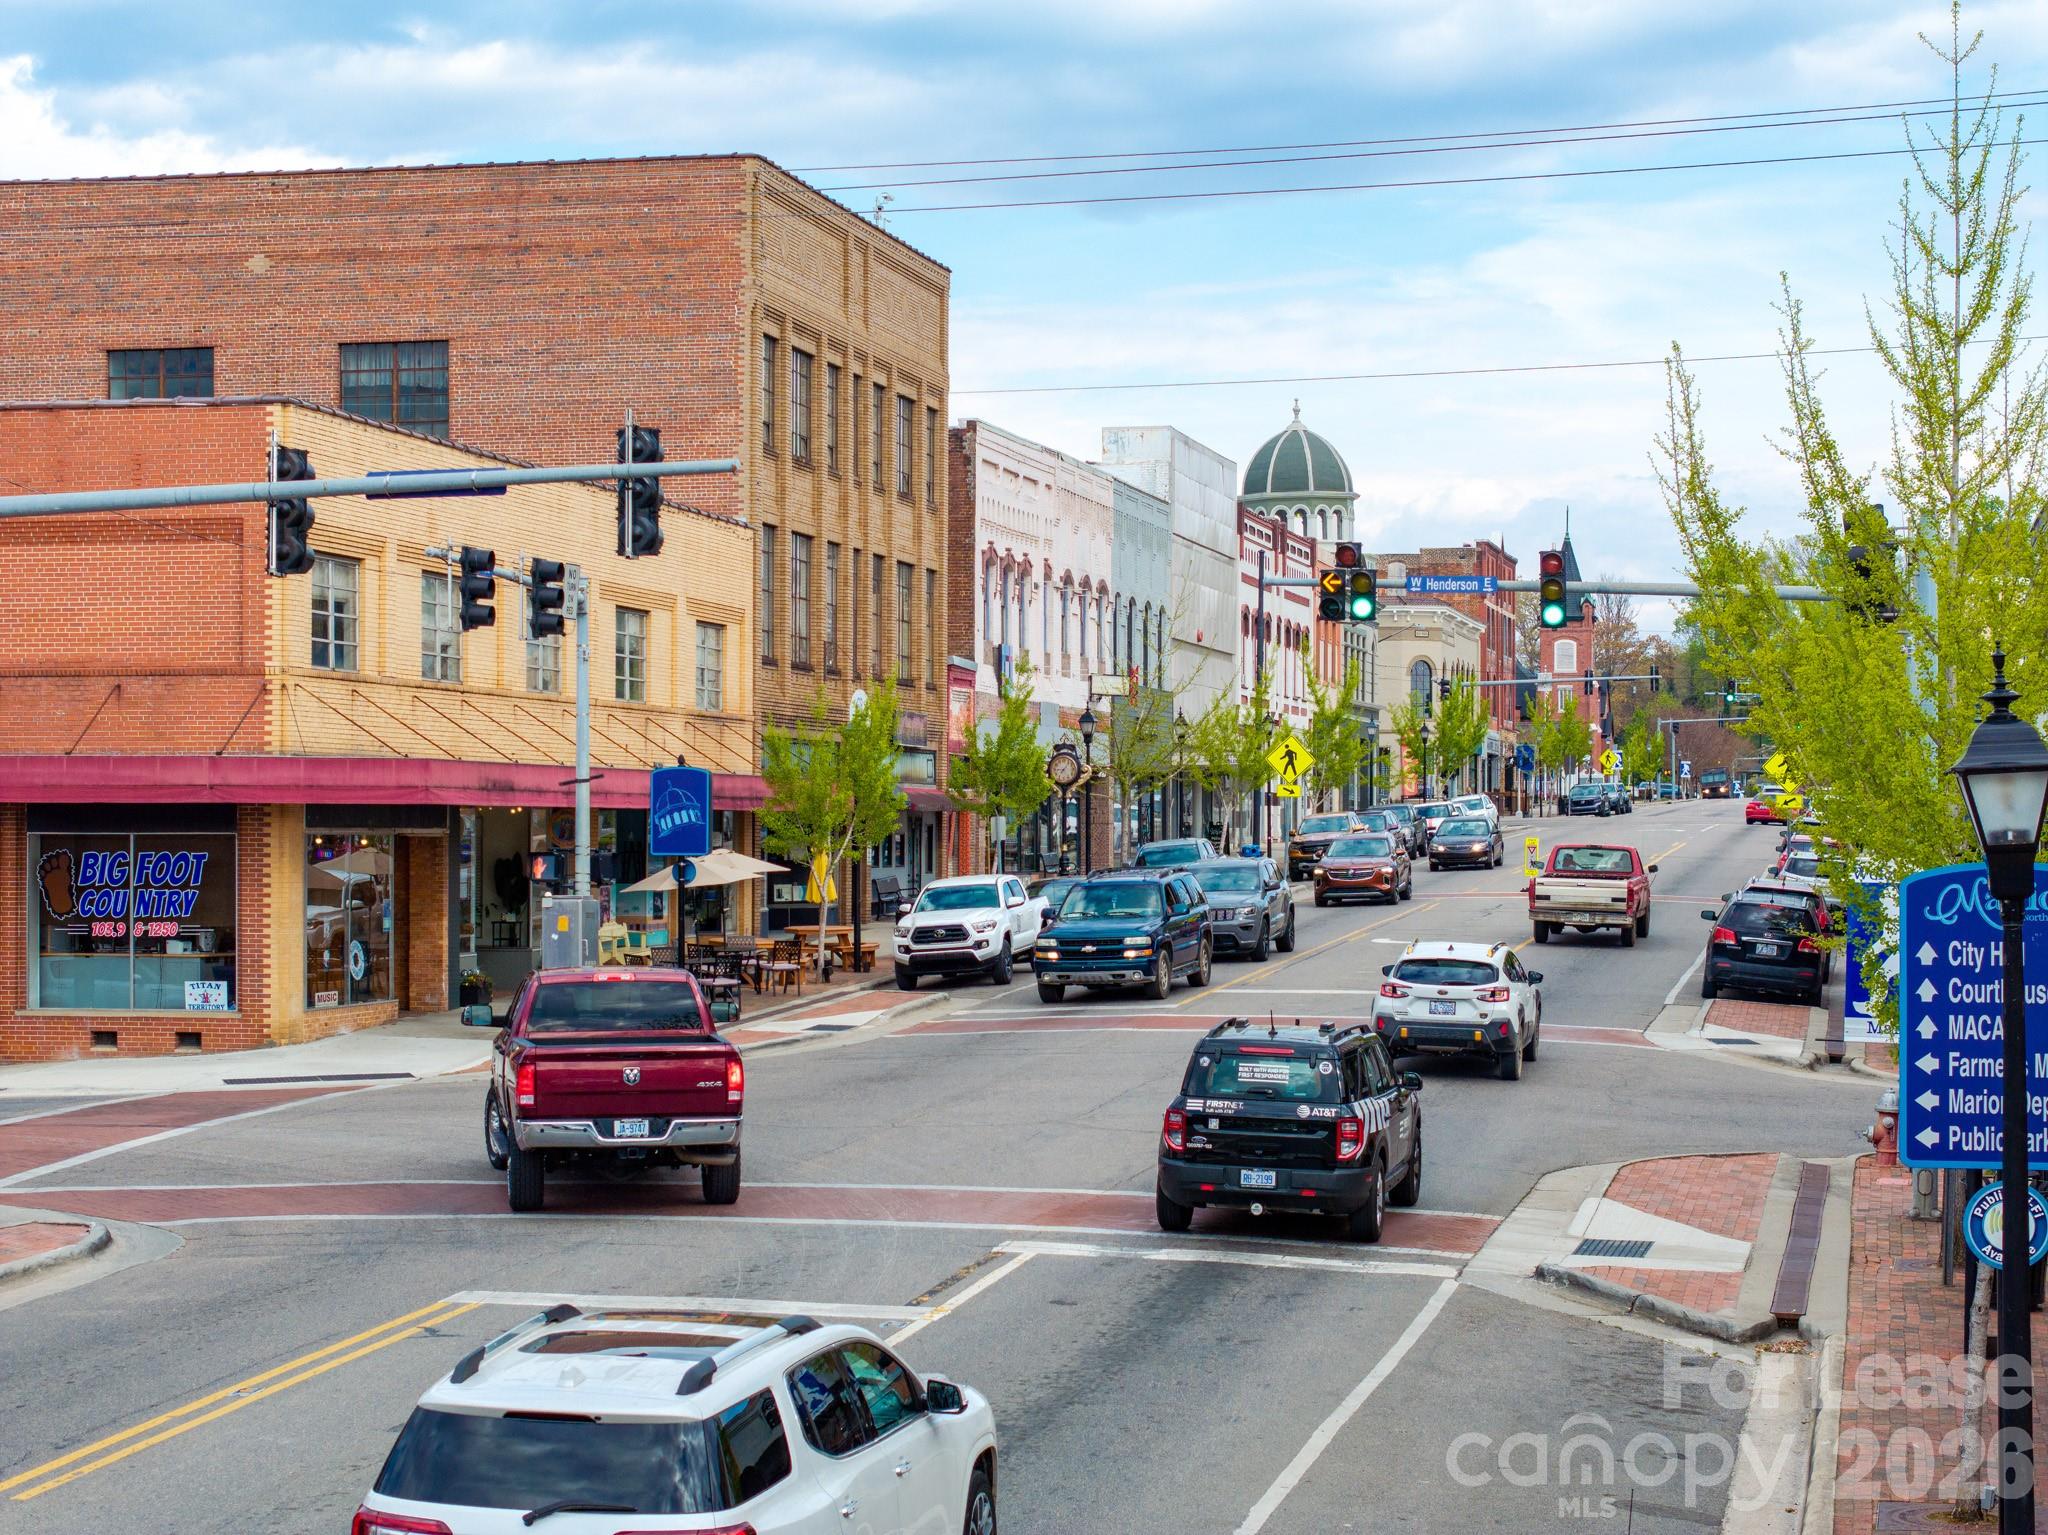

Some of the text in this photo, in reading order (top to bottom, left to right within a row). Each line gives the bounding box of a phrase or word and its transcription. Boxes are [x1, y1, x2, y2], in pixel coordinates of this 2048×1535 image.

[1411, 577, 1491, 590] W Henderson E
[77, 850, 208, 887] BIG FOOT
[91, 921, 179, 938] 103.9 & 1250
[1948, 940, 1985, 973] City
[190, 982, 222, 990] TITAN
[316, 992, 337, 1003] MUSIC
[1948, 1014, 2004, 1041] MACA
[1311, 1107, 1338, 1117] AT&T
[1948, 1125, 2004, 1152] Public
[1973, 1190, 2003, 1219] Publi
